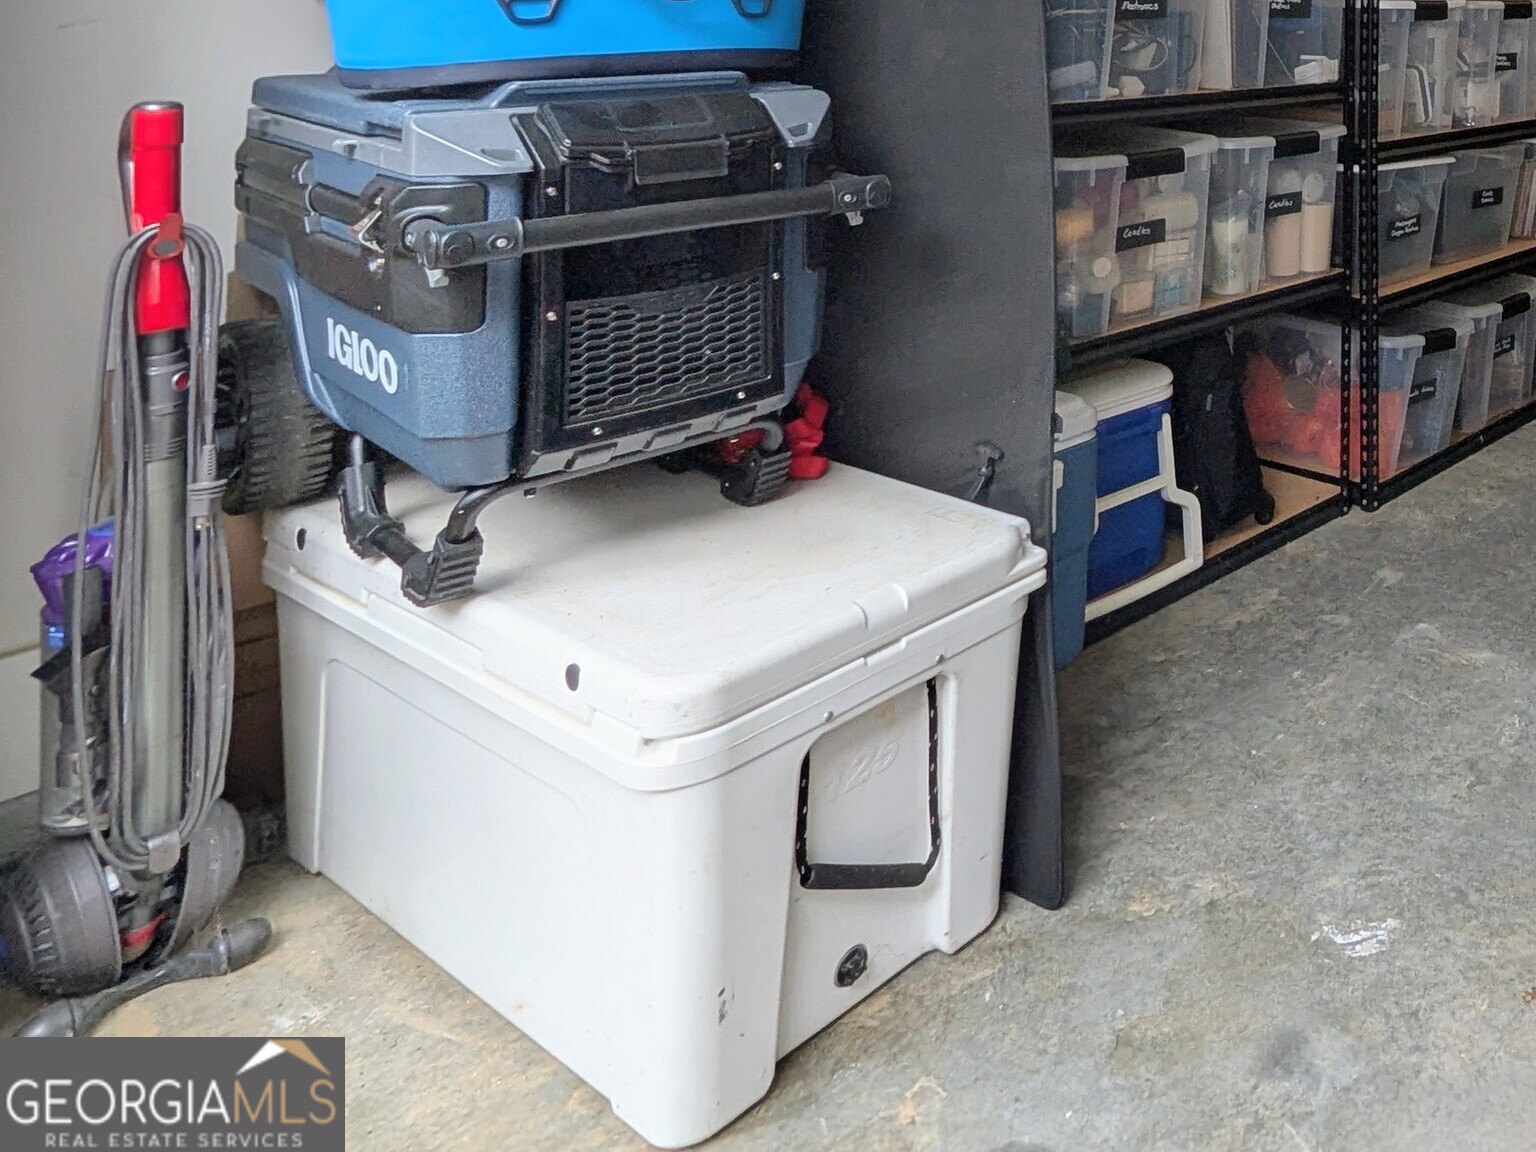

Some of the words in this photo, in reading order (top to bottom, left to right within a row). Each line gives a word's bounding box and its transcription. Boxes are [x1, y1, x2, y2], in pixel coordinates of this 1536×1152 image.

[1269, 198, 1293, 210] Candles
[1123, 226, 1151, 238] Candles
[327, 317, 398, 395] IGLOO
